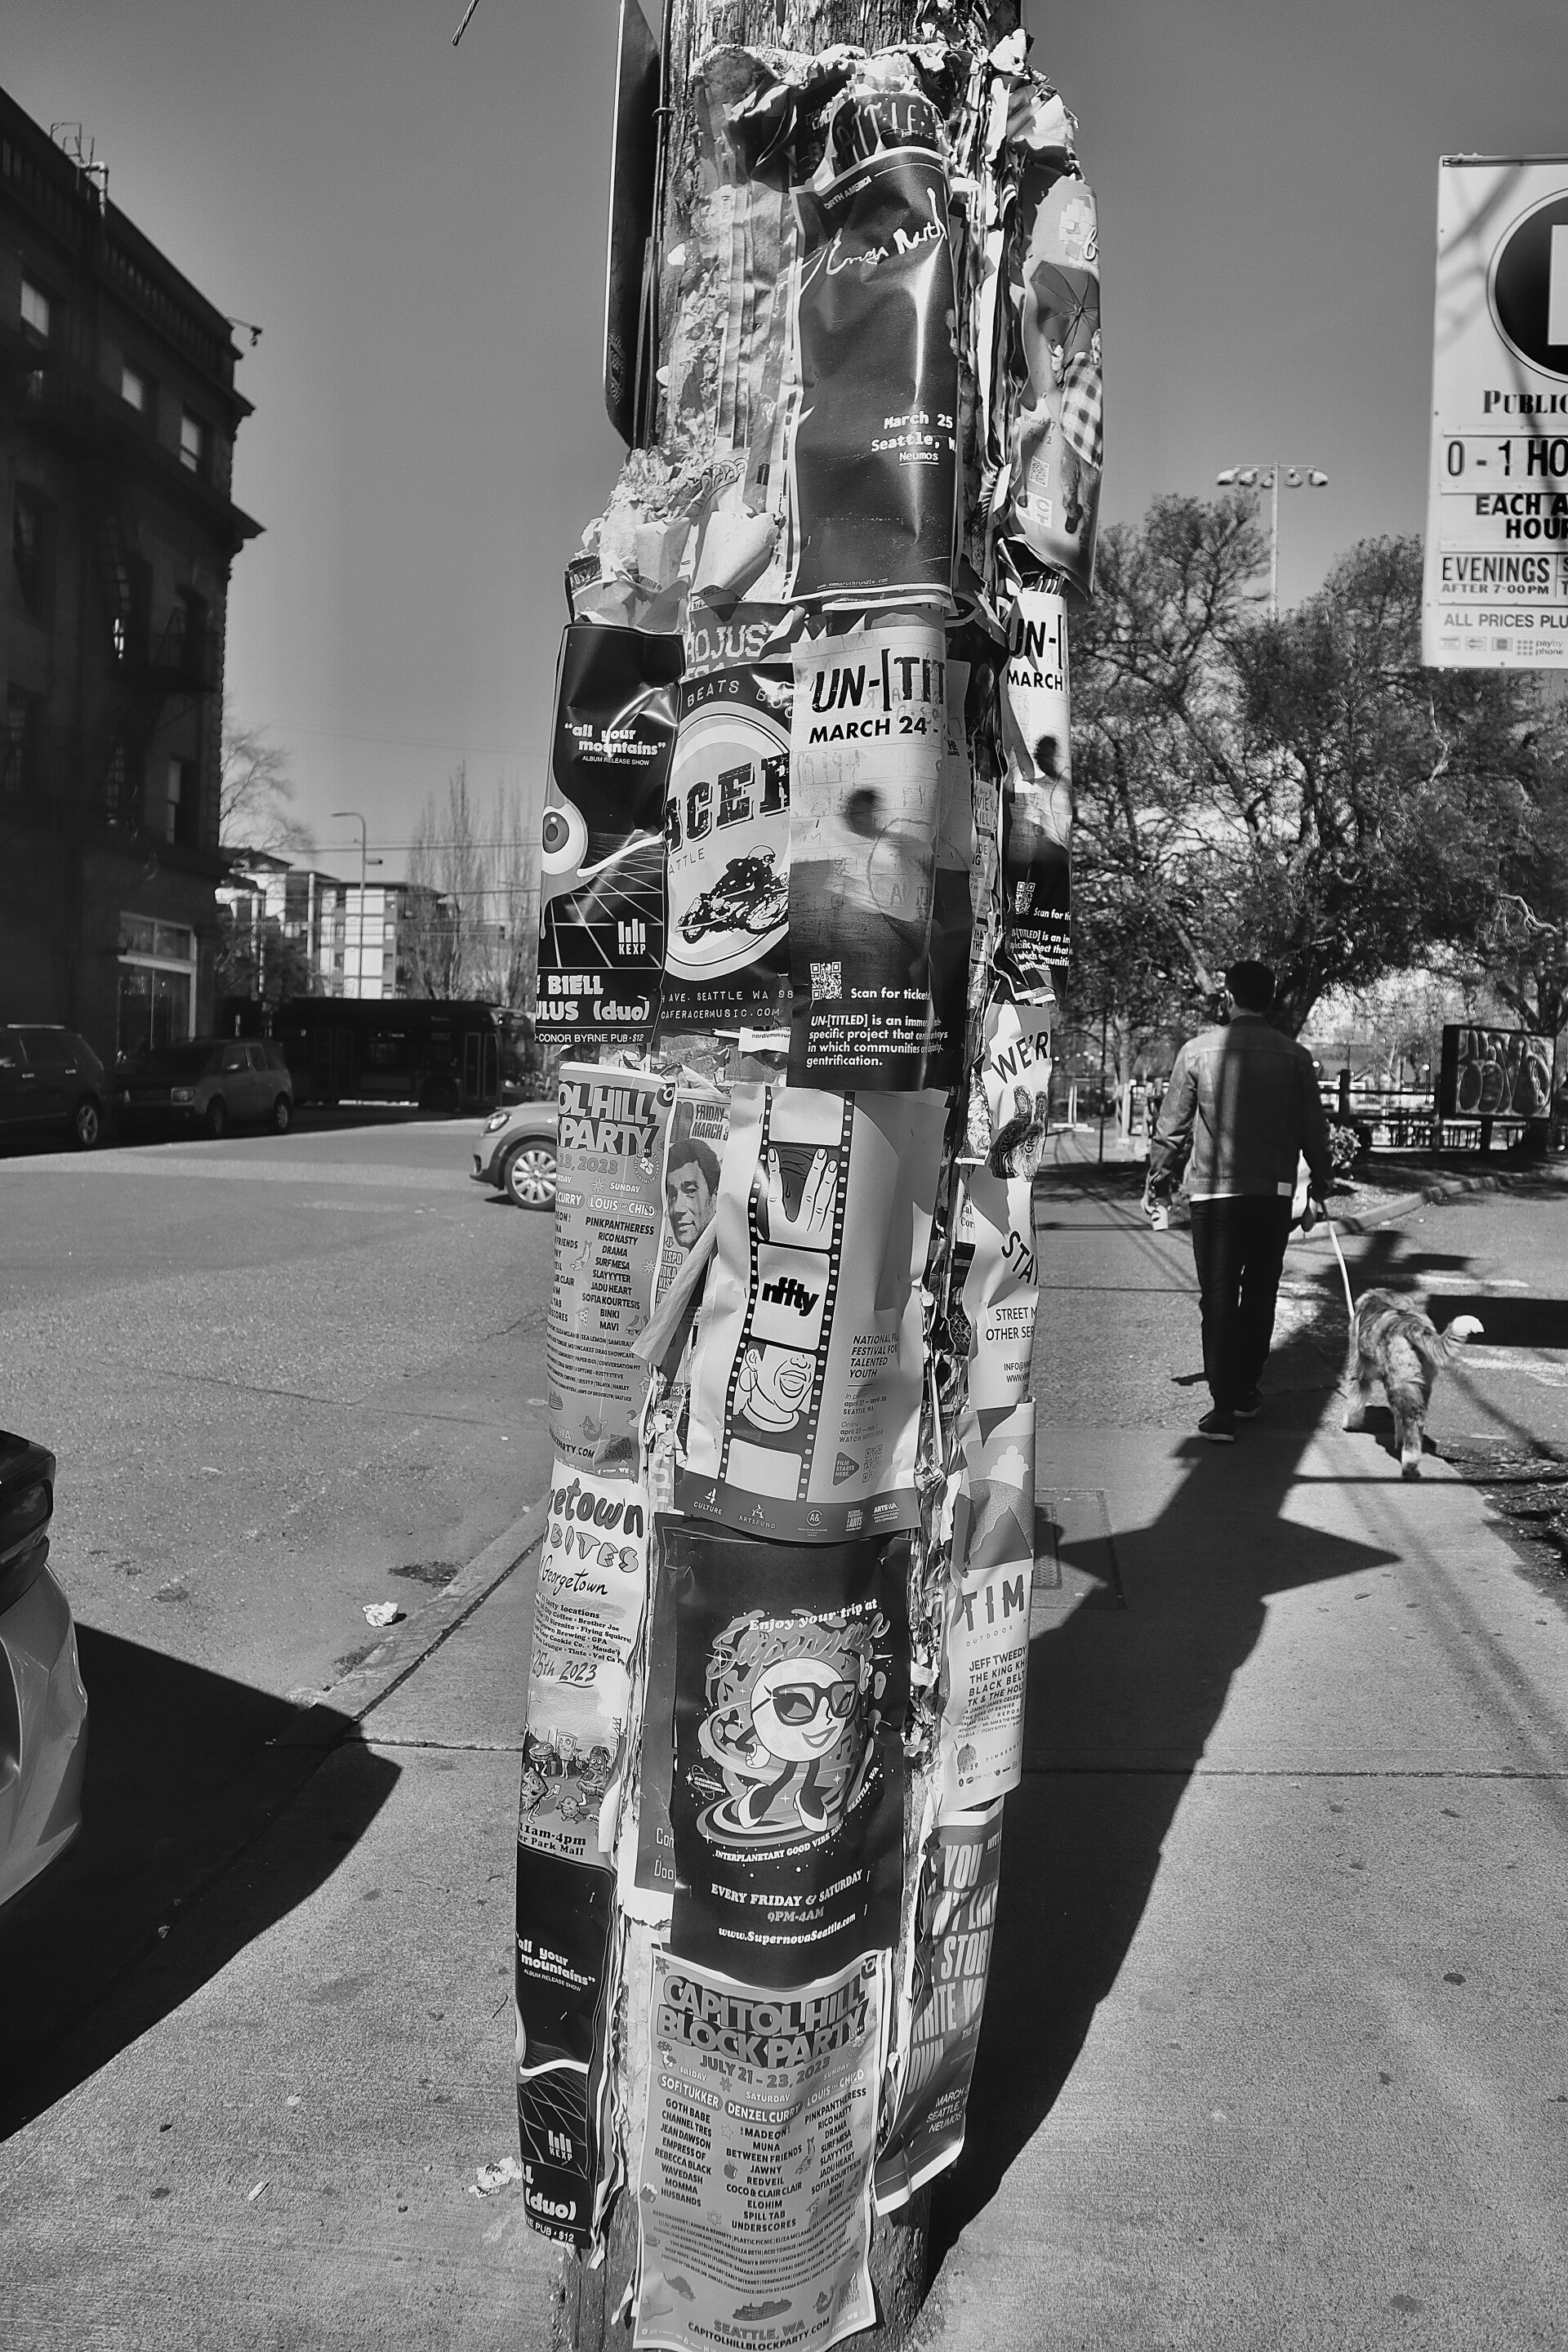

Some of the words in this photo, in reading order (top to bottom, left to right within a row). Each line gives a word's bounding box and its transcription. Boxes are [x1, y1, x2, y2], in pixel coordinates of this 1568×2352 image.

[884, 411, 929, 430] March
[937, 413, 953, 429] 25
[871, 431, 939, 452] Seattle,
[899, 452, 938, 461] Neumos
[1447, 440, 1464, 476] 0
[1499, 439, 1512, 476] 1
[1476, 494, 1541, 515] EACH
[1442, 557, 1550, 582] EVENINGS
[1441, 584, 1489, 595] AFTER
[1444, 613, 1472, 627] ALL
[1479, 614, 1534, 627] PRICES
[1007, 670, 1063, 691] MARCH
[687, 679, 739, 707] BEATS
[601, 728, 636, 742] your
[808, 718, 890, 744] MARCH
[898, 715, 927, 735] 24
[582, 755, 603, 764] ALBUM
[604, 756, 629, 764] RELEASE
[630, 758, 649, 766] SHOW
[668, 848, 705, 875] ATTLE
[618, 944, 646, 955] KEXP
[548, 974, 604, 995] BIELL
[850, 987, 877, 999] Scan
[881, 987, 900, 999] for
[668, 993, 690, 1003] AVE.
[697, 991, 742, 1001] SEATTLE
[752, 991, 768, 1000] WA
[778, 990, 794, 999] 98
[593, 1000, 650, 1021] (duo)
[661, 1008, 779, 1020] CAFERACERMUSIC.COM
[811, 1013, 869, 1028] UN-[TITLED]
[872, 1014, 882, 1025] is
[885, 1017, 902, 1026] an
[539, 1033, 571, 1043] CONOR
[574, 1033, 608, 1042] BYRNE
[611, 1033, 628, 1042] PUB
[632, 1033, 644, 1042] $12
[809, 1028, 844, 1041] specific
[847, 1027, 890, 1042] project
[893, 1027, 914, 1040] that
[808, 1042, 817, 1053] in
[819, 1040, 850, 1053] which
[853, 1041, 920, 1054] communities
[806, 1055, 883, 1068] gentrification.
[591, 1086, 656, 1125] HILL
[696, 1104, 725, 1122] FRIDAY
[560, 1117, 657, 1156] PARTY
[693, 1121, 722, 1140] MARCH
[577, 1156, 618, 1174] 2023
[609, 1183, 640, 1193] SUNDAY
[590, 1196, 618, 1210] LOUIS
[629, 1202, 654, 1216] CHILD
[586, 1217, 654, 1235] PINKPANTHERESS
[602, 1245, 627, 1257] DRAMA
[593, 1269, 630, 1283] SLAYYYTER
[761, 1276, 820, 1316] nffty
[599, 1308, 620, 1319] BINKI
[996, 1307, 1028, 1321] STREET
[599, 1321, 619, 1331] MAVI
[986, 1327, 1020, 1341] OTHER
[853, 1334, 891, 1344] NATIONAL
[851, 1346, 885, 1356] FESTIVAL
[850, 1357, 888, 1367] TALENTED
[849, 1369, 877, 1379] YOUTH
[693, 1501, 723, 1515] CULTURE
[738, 1515, 776, 1529] ARTSFUND
[550, 1523, 639, 1573] BITES
[541, 1554, 608, 1596] Georgetown
[553, 1611, 572, 1621] Coffee
[578, 1618, 606, 1628] Brother
[560, 1604, 600, 1619] locations
[749, 1619, 795, 1632] Enjoy
[798, 1610, 838, 1628] your
[840, 1603, 862, 1619] trip
[865, 1598, 878, 1611] at
[557, 1629, 586, 1641] Brewing
[591, 1637, 608, 1645] GPA
[581, 1626, 603, 1637] Flying
[969, 1656, 991, 1672] JEFF
[993, 1645, 1027, 1667] TWEEDY
[559, 1660, 598, 1682] 2023
[970, 1672, 988, 1685] THE
[991, 1664, 1013, 1678] KING
[969, 1680, 1002, 1697] BLACK
[1006, 1670, 1026, 1685] BELT
[519, 1823, 586, 1845] 11am-4pm
[532, 1838, 556, 1851] Park
[559, 1843, 584, 1855] Mall
[715, 1849, 785, 1862] INTERPLANETARY
[786, 1842, 810, 1855] GOOD
[943, 1843, 983, 1889] YOU
[711, 1883, 748, 1904] EVERY
[750, 1893, 803, 1907] FRIDAY
[805, 1894, 817, 1905] &
[818, 1869, 863, 1903] SATURDAY
[768, 1906, 824, 1923] 9PM-4AM
[718, 1913, 856, 1945] www.SupernovaSeattle.com
[539, 1947, 568, 1967] your
[663, 1976, 801, 2037] CAPITOL
[805, 1975, 866, 2030] HILL
[657, 2004, 766, 2069] BLOCK
[767, 1999, 870, 2069] PARTY
[679, 2067, 707, 2081] FRIDAY
[700, 2055, 736, 2076] JULY
[738, 2067, 754, 2084] 21
[767, 2074, 793, 2088] 23,
[797, 2056, 831, 2085] 2023
[661, 2075, 684, 2093] SOFI
[683, 2084, 719, 2109] TUKKER
[745, 2091, 791, 2102] SATURDAY
[936, 2087, 964, 2108] MARCH
[666, 2098, 688, 2114] GOTH
[689, 2107, 710, 2123] BABE
[728, 2102, 768, 2122] DENZEL
[768, 2103, 800, 2123] CURRY
[929, 2110, 962, 2133] NEUMOS
[549, 2146, 572, 2162] KEXP
[726, 2148, 768, 2163] BETWEEN
[770, 2145, 802, 2163] FRIENDS
[752, 2141, 780, 2151] MUNA
[662, 2163, 703, 2185] WAVEDASH
[746, 2176, 784, 2185] REDVEIL
[665, 2177, 698, 2194] MOMMA
[525, 2187, 577, 2221] (duo)
[661, 2188, 702, 2207] HUSBANDS
[536, 2221, 552, 2236] PUB
[559, 2230, 574, 2243] $12
[732, 2219, 796, 2233] UNDERSCORES
[688, 2316, 831, 2351] CAPITOLHILLBLOCKPARTY.COM
[714, 2319, 779, 2341] SEATTLE,
[782, 2318, 805, 2334] WA
